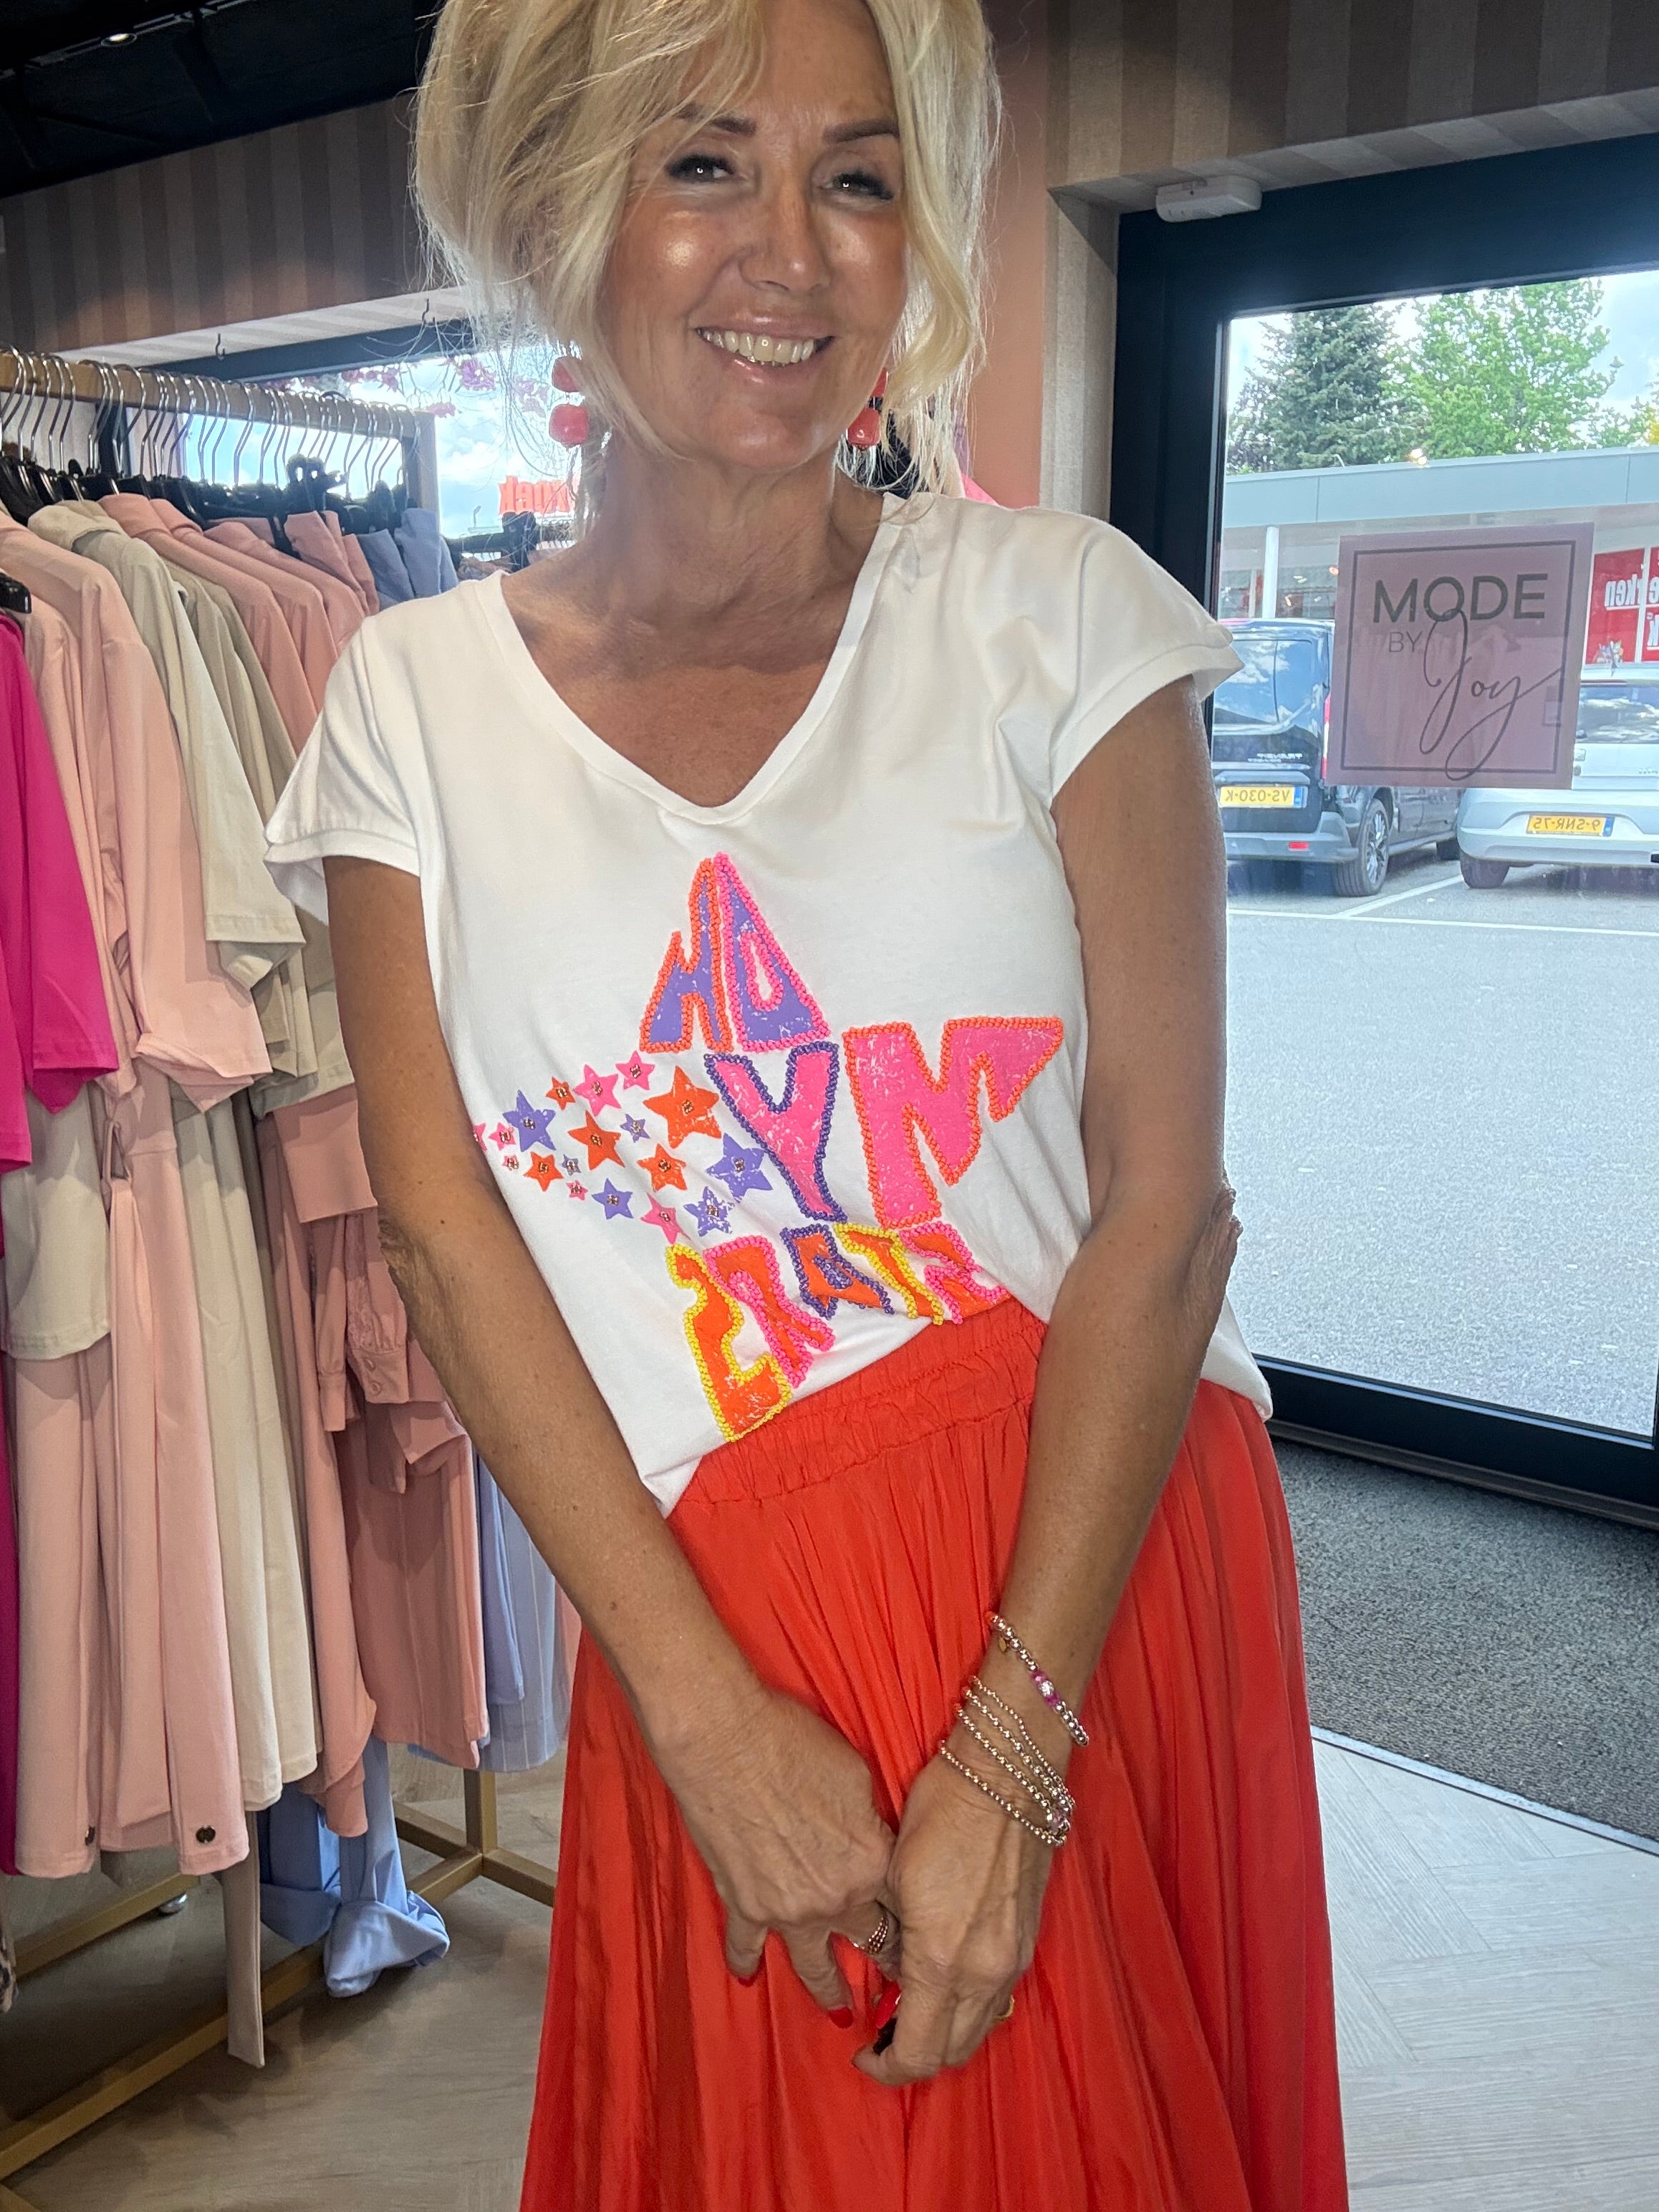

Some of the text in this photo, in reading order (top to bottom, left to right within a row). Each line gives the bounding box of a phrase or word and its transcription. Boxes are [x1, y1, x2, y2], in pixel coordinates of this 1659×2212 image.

[1372, 573, 1548, 623] MODE
[1388, 630, 1423, 653] BY
[1419, 608, 1562, 782] Joy
